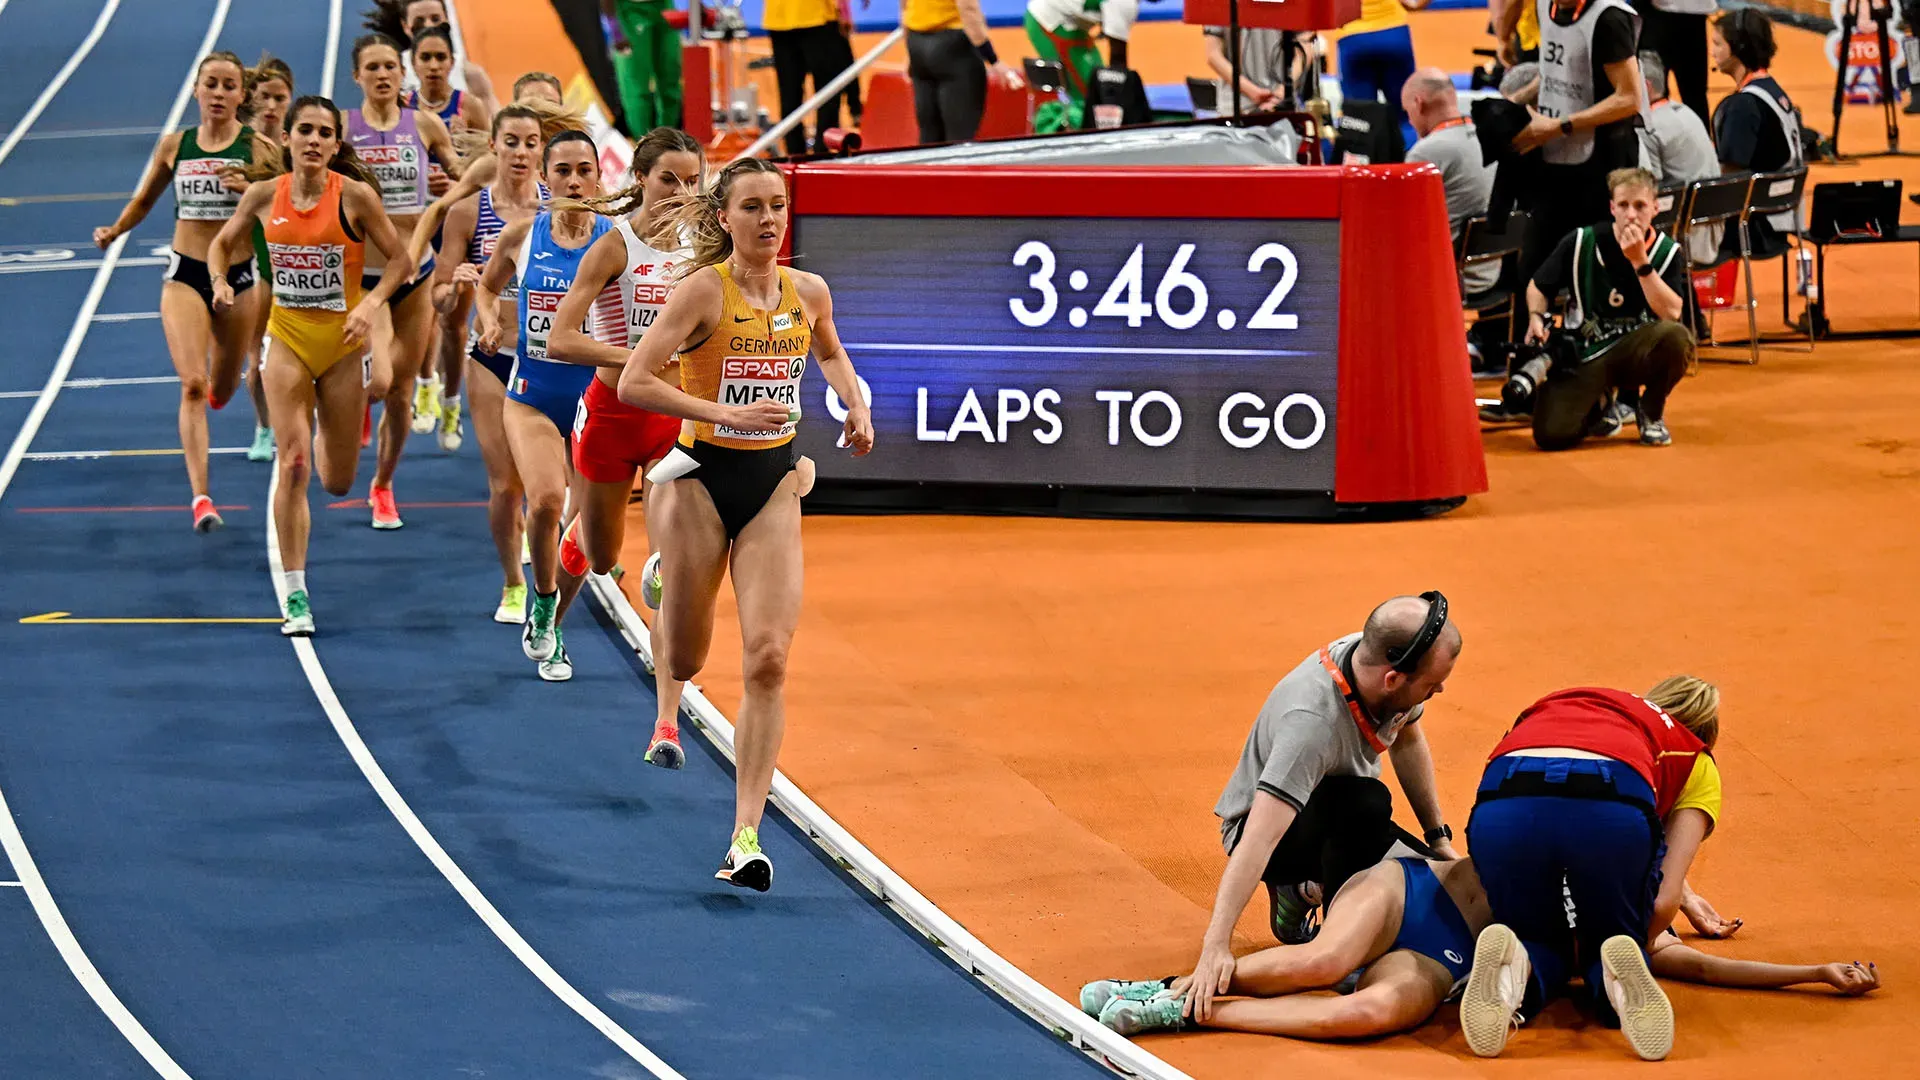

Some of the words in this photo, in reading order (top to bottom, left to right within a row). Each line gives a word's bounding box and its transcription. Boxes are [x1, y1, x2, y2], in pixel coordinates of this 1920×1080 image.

[1544, 41, 1564, 66] 32
[272, 253, 322, 268] SPAR
[276, 270, 342, 290] GARCÍA
[1009, 241, 1298, 330] 3:46.2
[1608, 287, 1624, 307] 6
[729, 336, 805, 354] GERMANY
[726, 361, 789, 377] SPAR
[725, 384, 795, 405] MEYER
[917, 387, 1062, 444] LAPS
[1096, 390, 1182, 447] TO
[1218, 391, 1326, 449] GO
